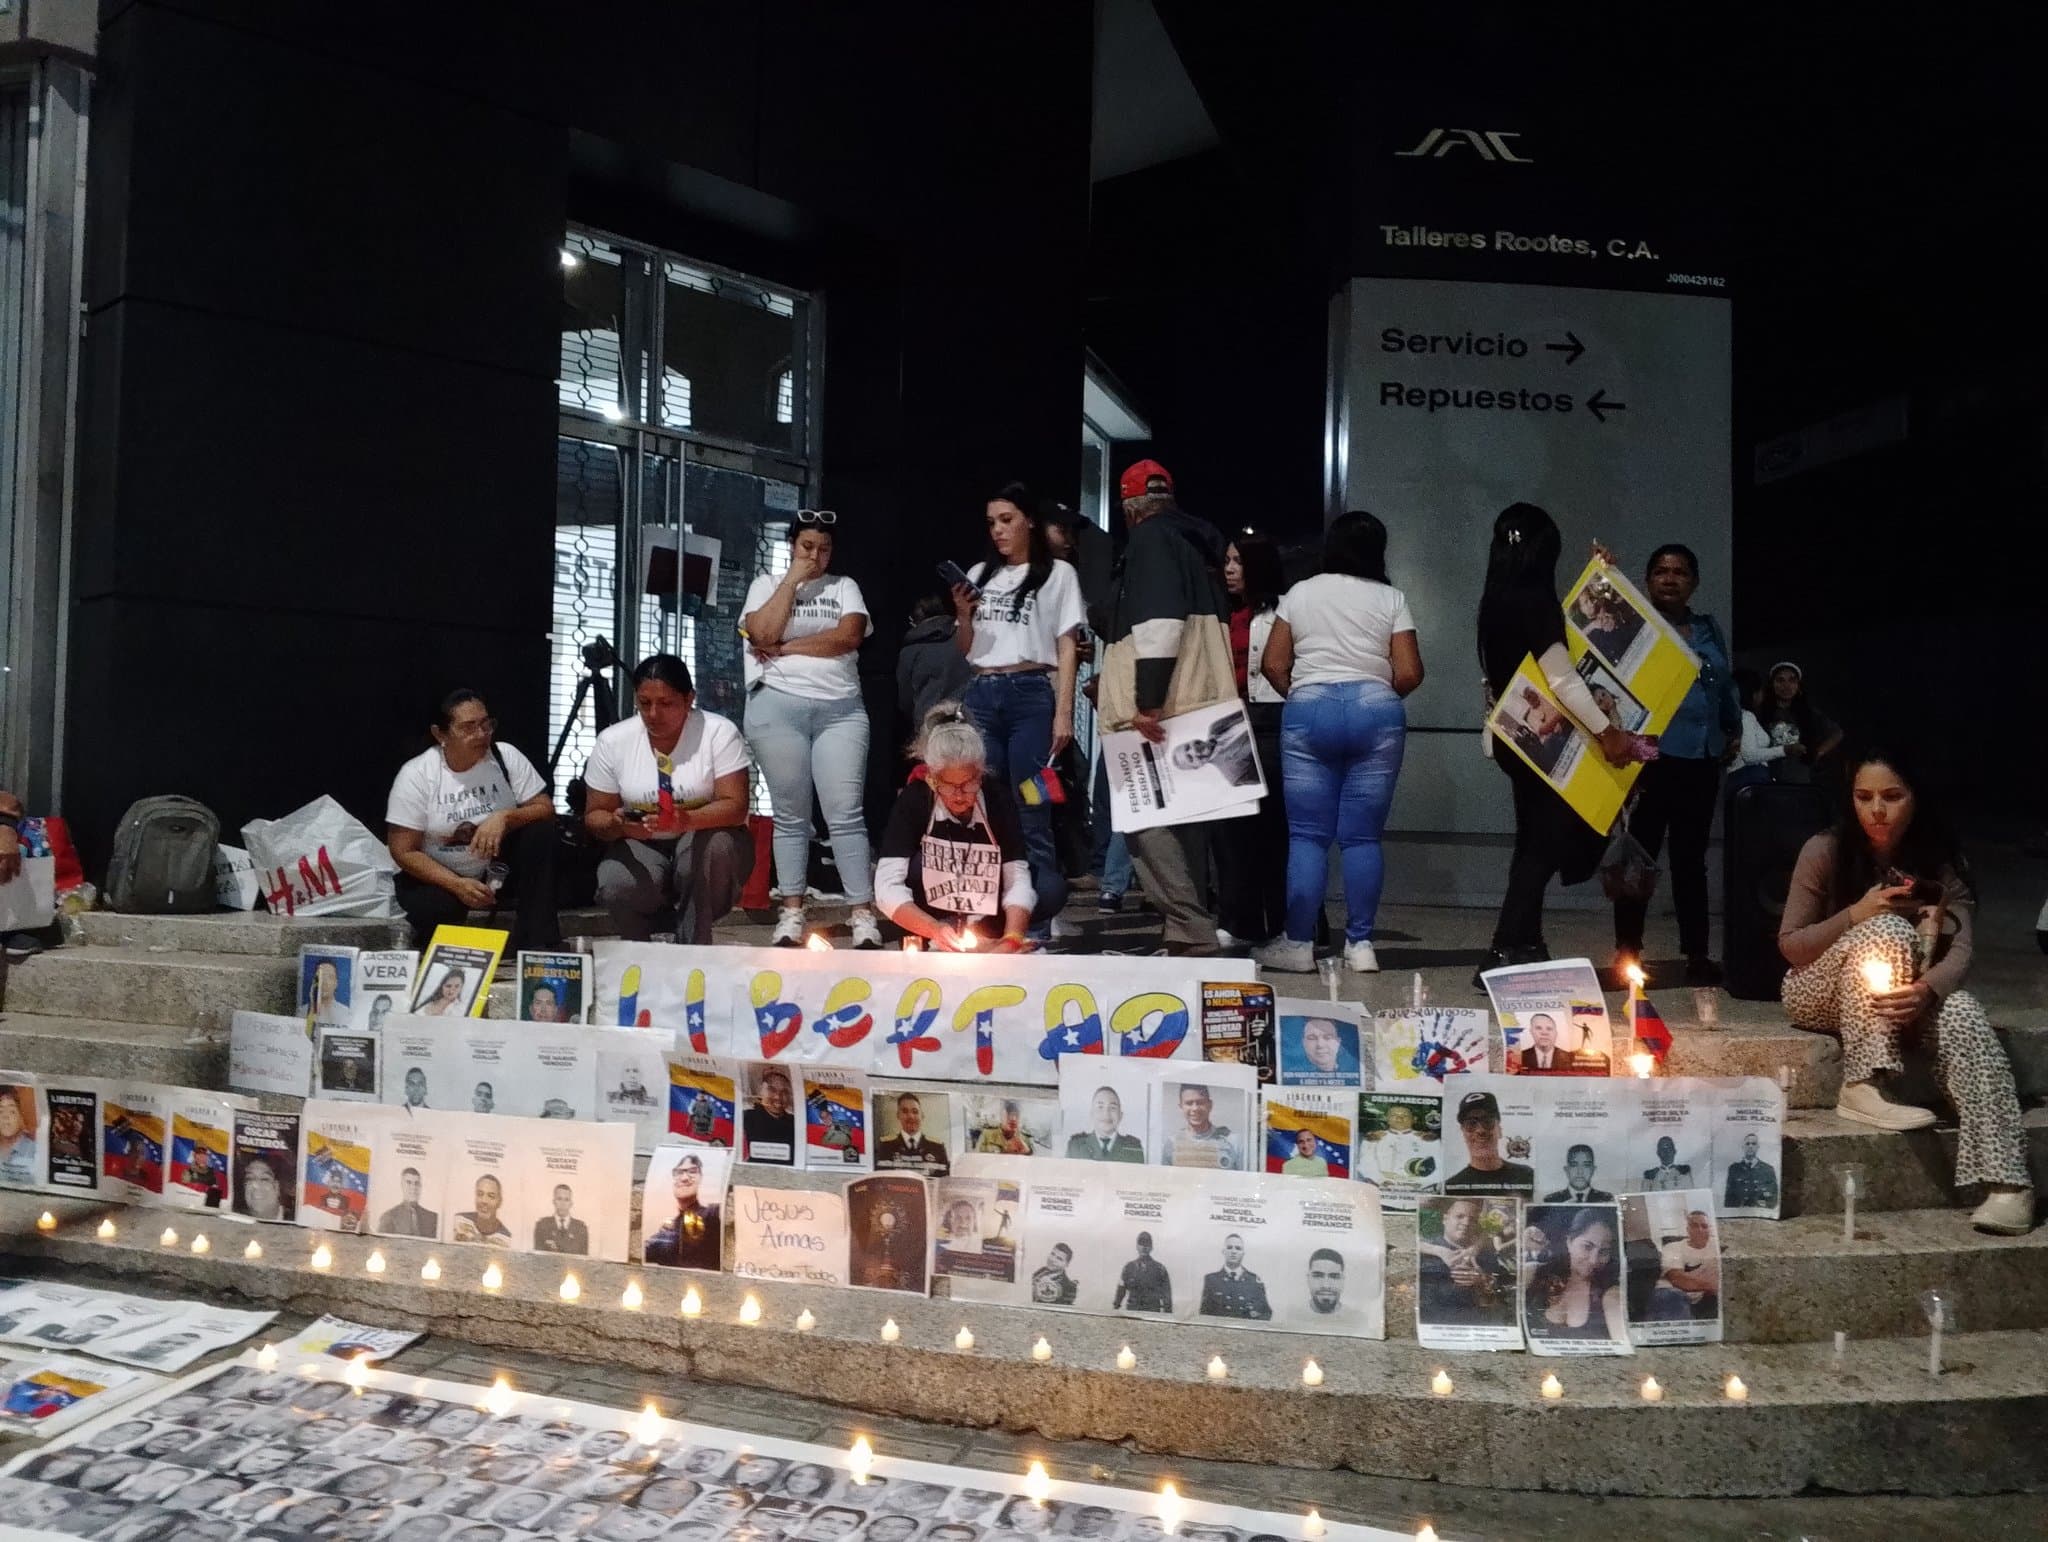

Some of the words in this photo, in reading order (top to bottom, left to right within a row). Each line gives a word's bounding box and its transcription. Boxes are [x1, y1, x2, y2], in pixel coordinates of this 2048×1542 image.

[1380, 224, 1486, 250] Talleres
[1495, 231, 1598, 258] Rootes,
[1607, 239, 1659, 261] C.A.
[1381, 328, 1528, 358] Servicio
[1379, 381, 1574, 413] Repuestos
[975, 608, 1031, 626] OLITICOS
[1118, 752, 1140, 813] FERNANDO
[1131, 752, 1151, 806] SERRANO
[363, 952, 409, 962] JACKSON
[363, 966, 408, 978] VERA
[1215, 989, 1241, 998] AHORA
[618, 964, 1189, 1076] LIBERTAD
[50, 1095, 95, 1107] LIBERTAD
[1371, 1095, 1439, 1105] DESAPARECIDO
[1124, 1202, 1162, 1211] RICARDO
[1222, 1207, 1254, 1217] MIGUEL
[1124, 1209, 1162, 1218] FONSECA
[1209, 1214, 1238, 1223] ANGEL
[1239, 1216, 1268, 1225] PLAZA
[1304, 1212, 1352, 1222] JEFFERSON
[1302, 1220, 1354, 1229] FERNANDEZ
[760, 1223, 825, 1252] Armas
